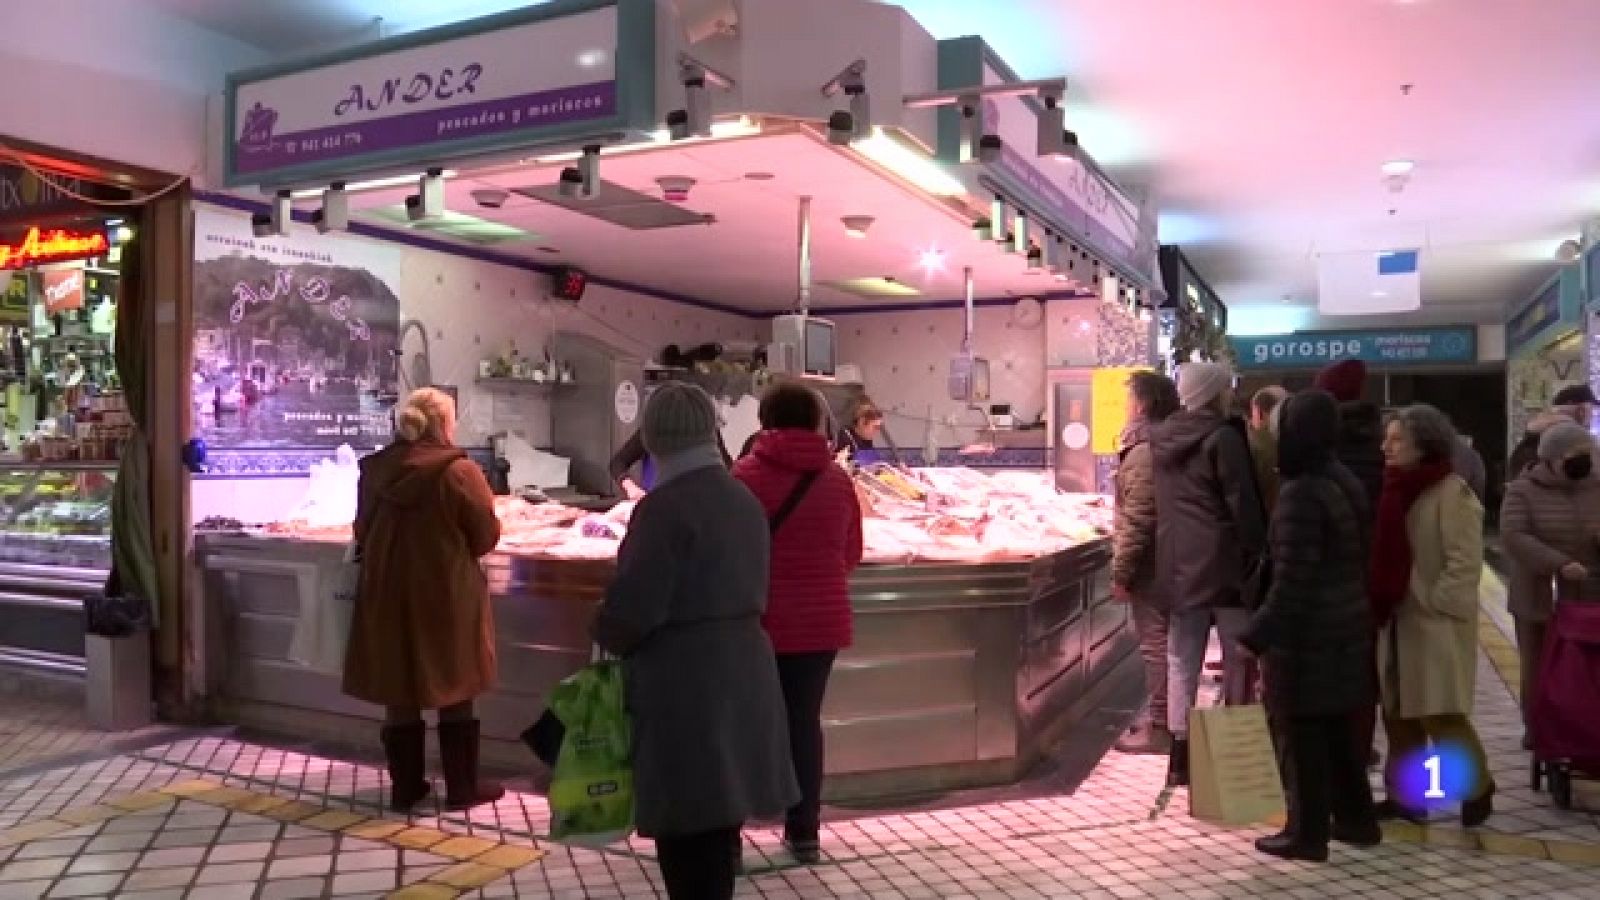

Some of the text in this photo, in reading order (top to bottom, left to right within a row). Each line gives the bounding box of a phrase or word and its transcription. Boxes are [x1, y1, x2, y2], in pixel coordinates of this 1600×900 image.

[334, 62, 484, 116] ANDER
[437, 95, 601, 135] pescados y mariscos
[229, 267, 371, 341] ANDER
[1254, 339, 1361, 363] gorospe
